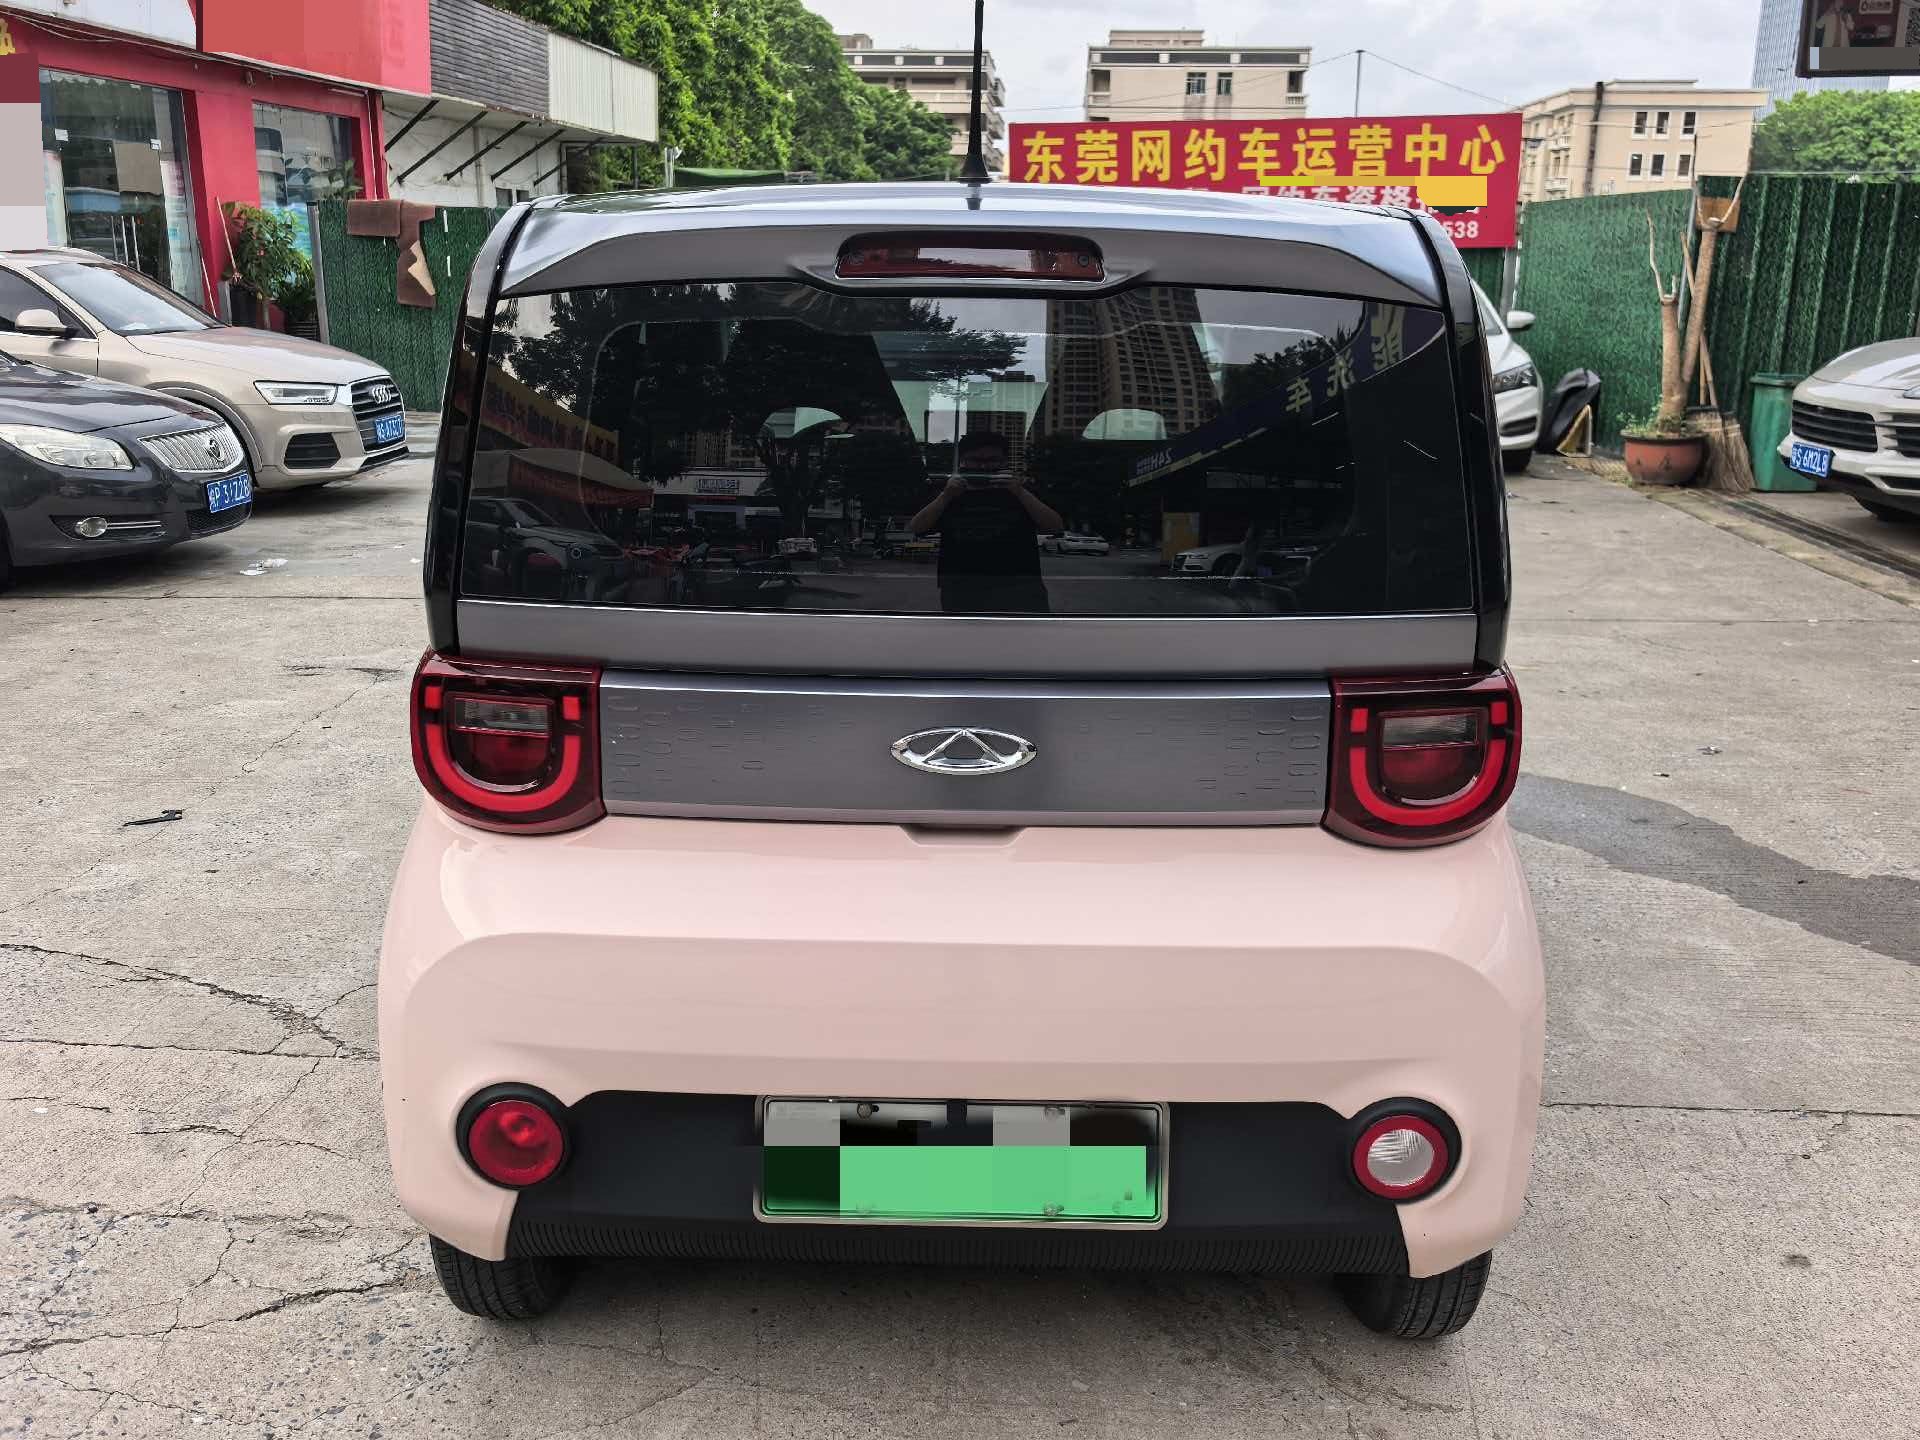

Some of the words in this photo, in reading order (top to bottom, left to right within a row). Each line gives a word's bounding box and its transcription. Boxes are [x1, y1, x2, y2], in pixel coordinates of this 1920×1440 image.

[1021, 122, 1506, 184] 东莞网约车运营中心
